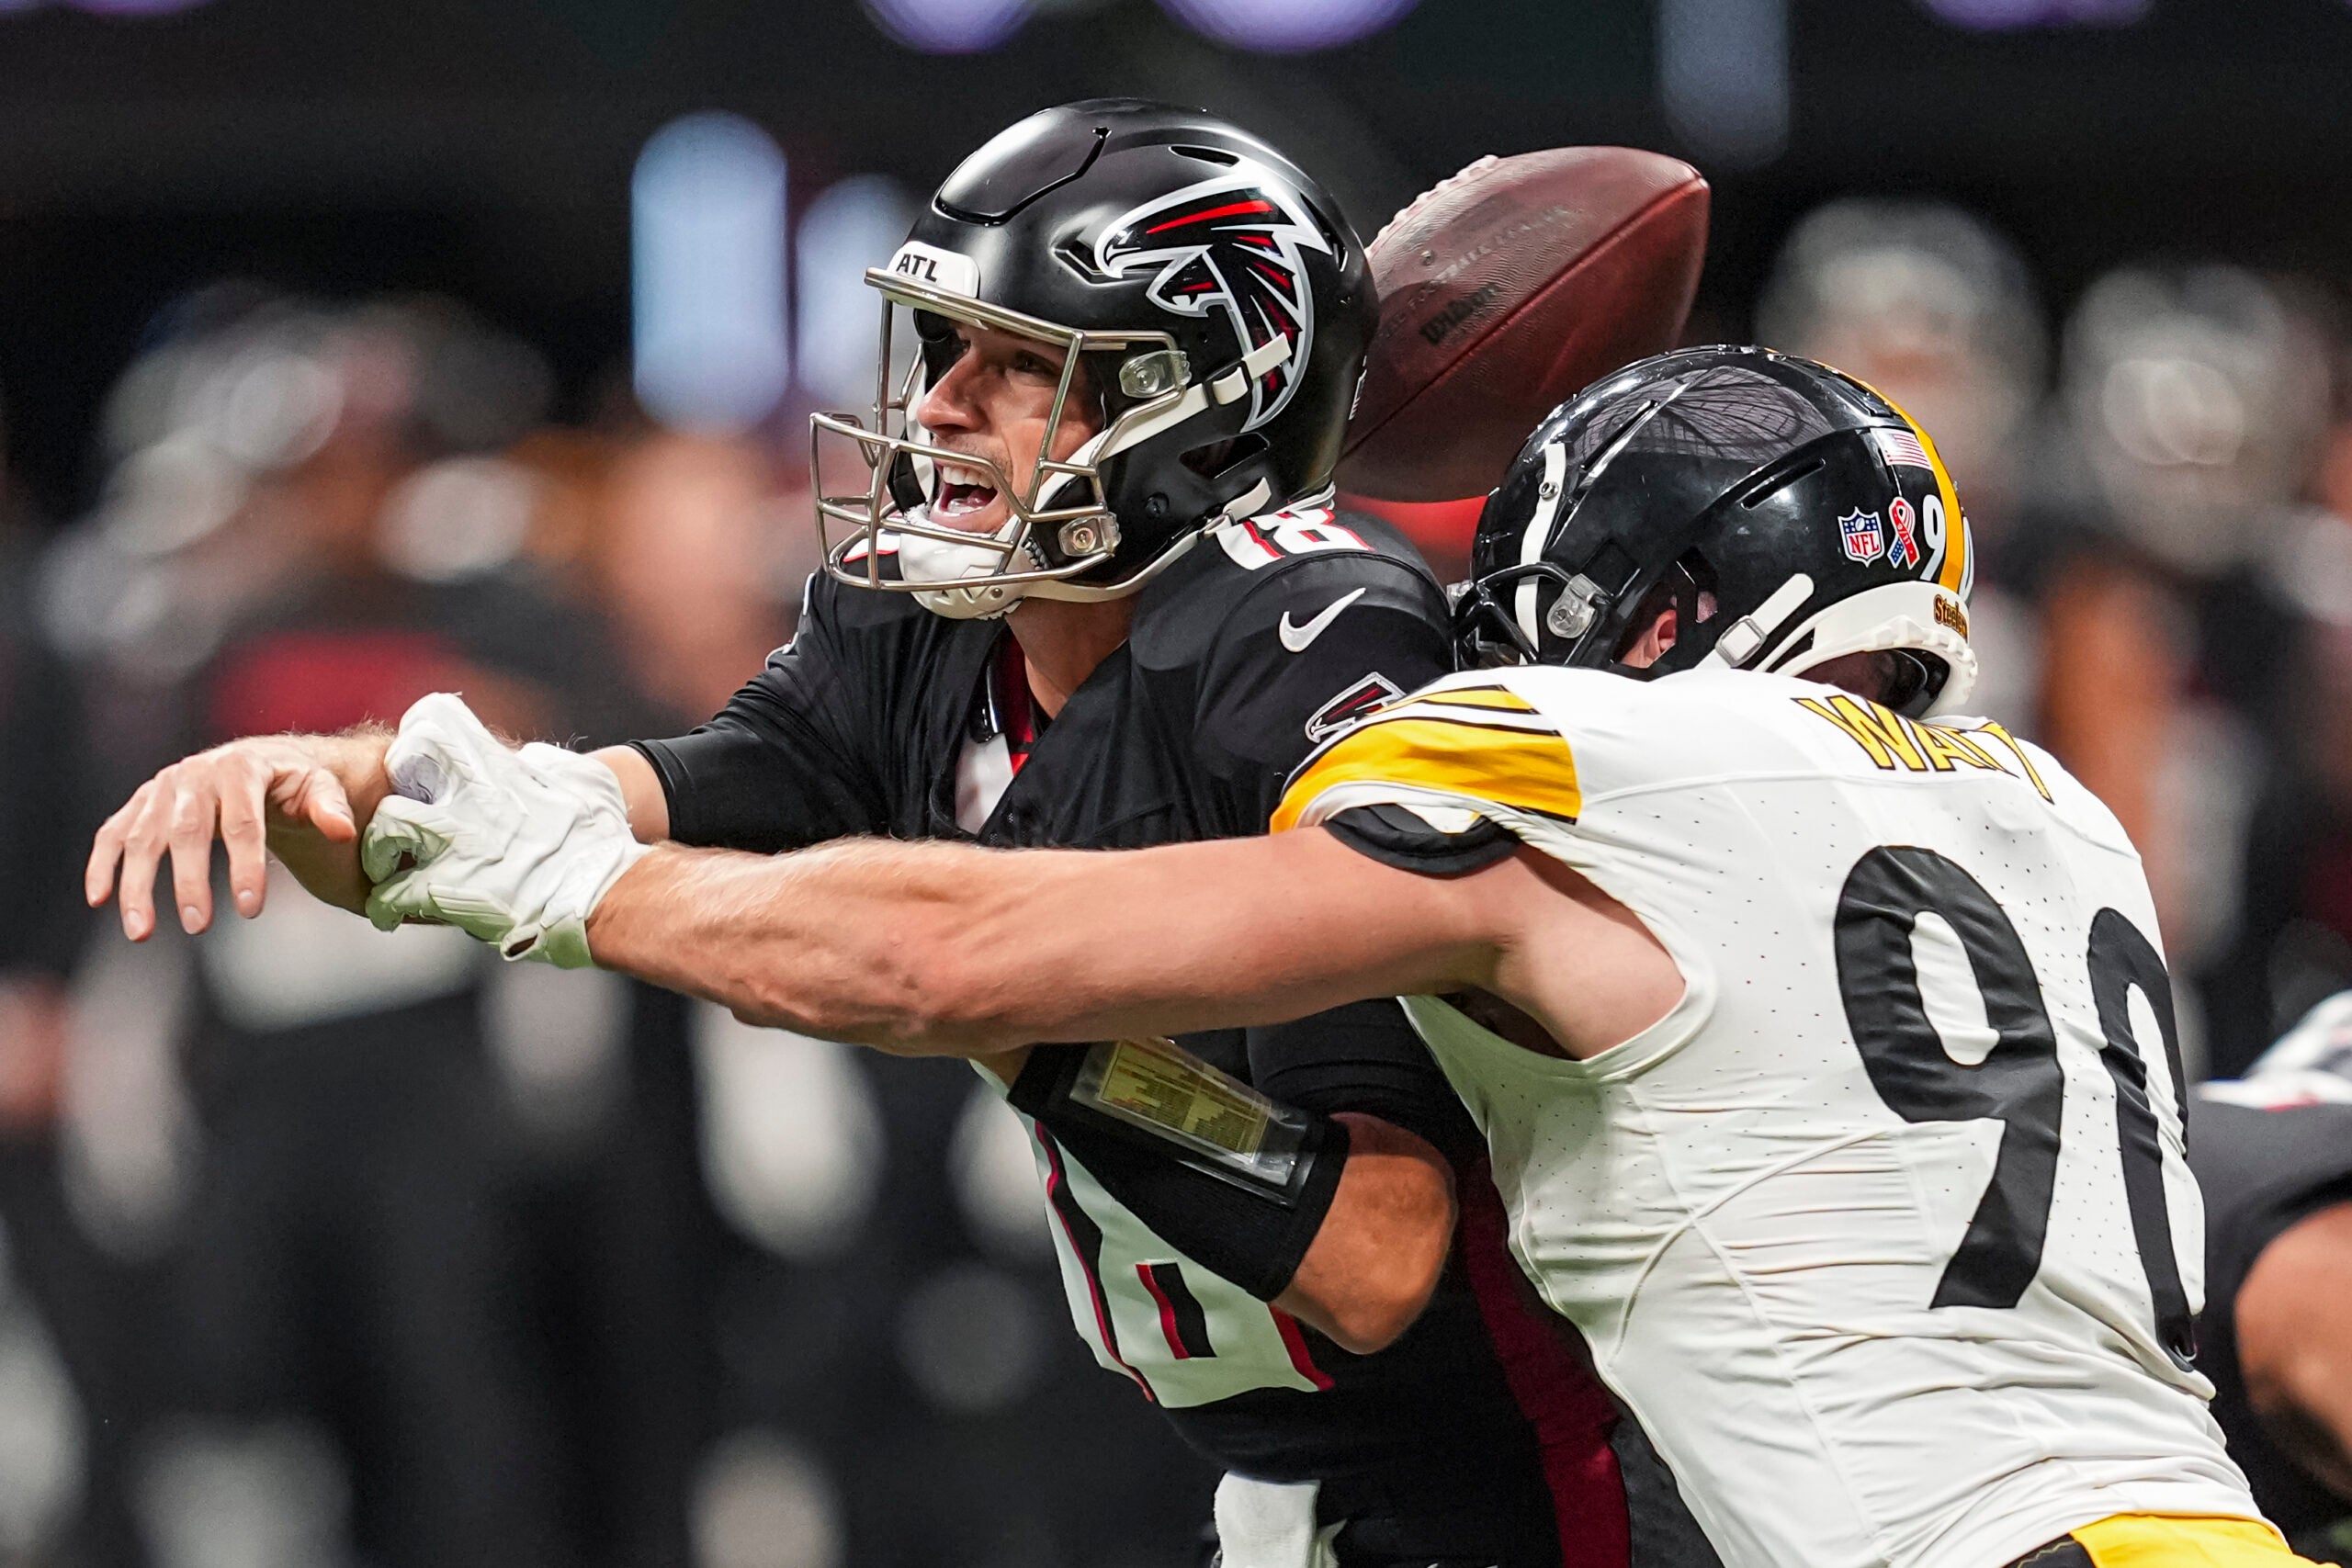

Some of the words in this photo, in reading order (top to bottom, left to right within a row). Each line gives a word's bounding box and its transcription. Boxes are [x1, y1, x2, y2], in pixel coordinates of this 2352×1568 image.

[896, 254, 938, 283] ATL
[1216, 507, 1375, 570] 18
[1848, 533, 1880, 557] NFL
[1897, 523, 1911, 545] 9/11
[1834, 845, 2191, 1371] 90
